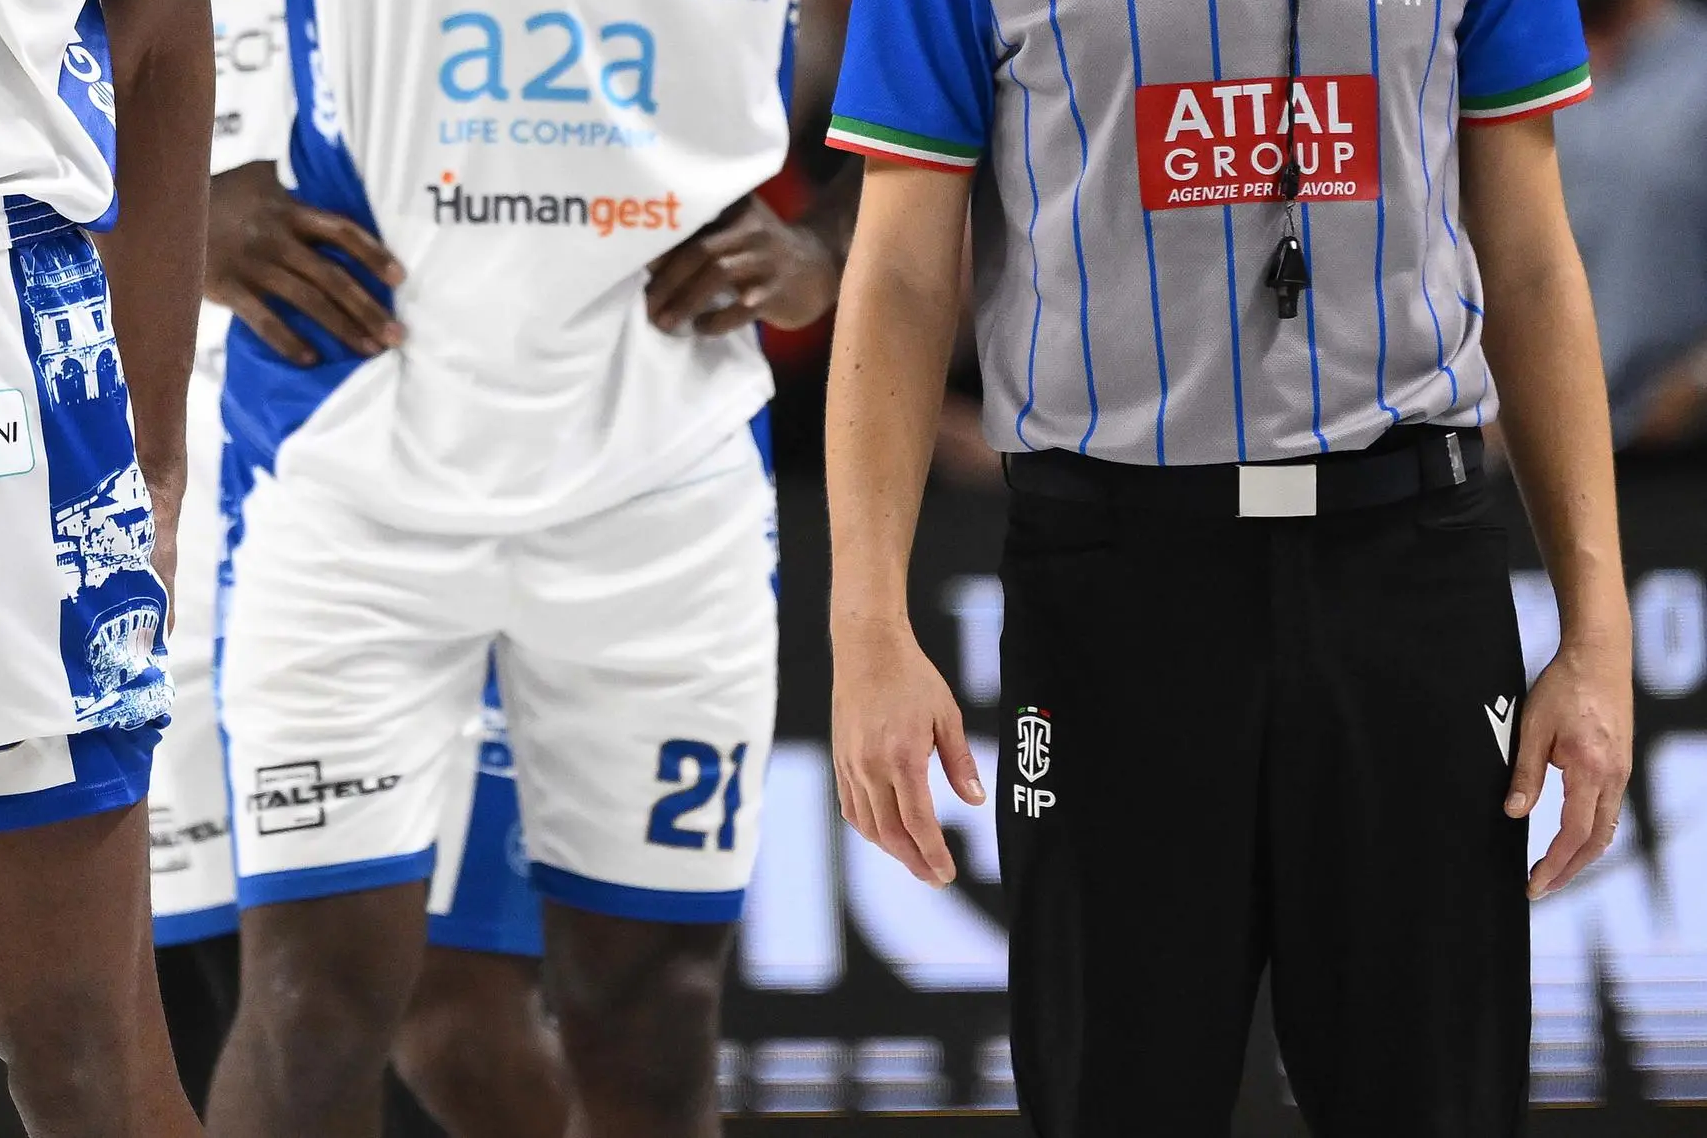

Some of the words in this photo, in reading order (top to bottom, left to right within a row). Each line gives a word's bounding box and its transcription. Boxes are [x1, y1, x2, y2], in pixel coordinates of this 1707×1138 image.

[438, 10, 659, 117] a2a
[439, 120, 498, 145] LIFE
[1164, 81, 1353, 142] ATTAL
[1164, 141, 1355, 181] GROUP
[426, 170, 682, 237] Humangest
[1168, 183, 1239, 203] AGENZIE
[1243, 183, 1274, 198] PER
[646, 739, 750, 851] 21
[1014, 783, 1057, 819] FIP
